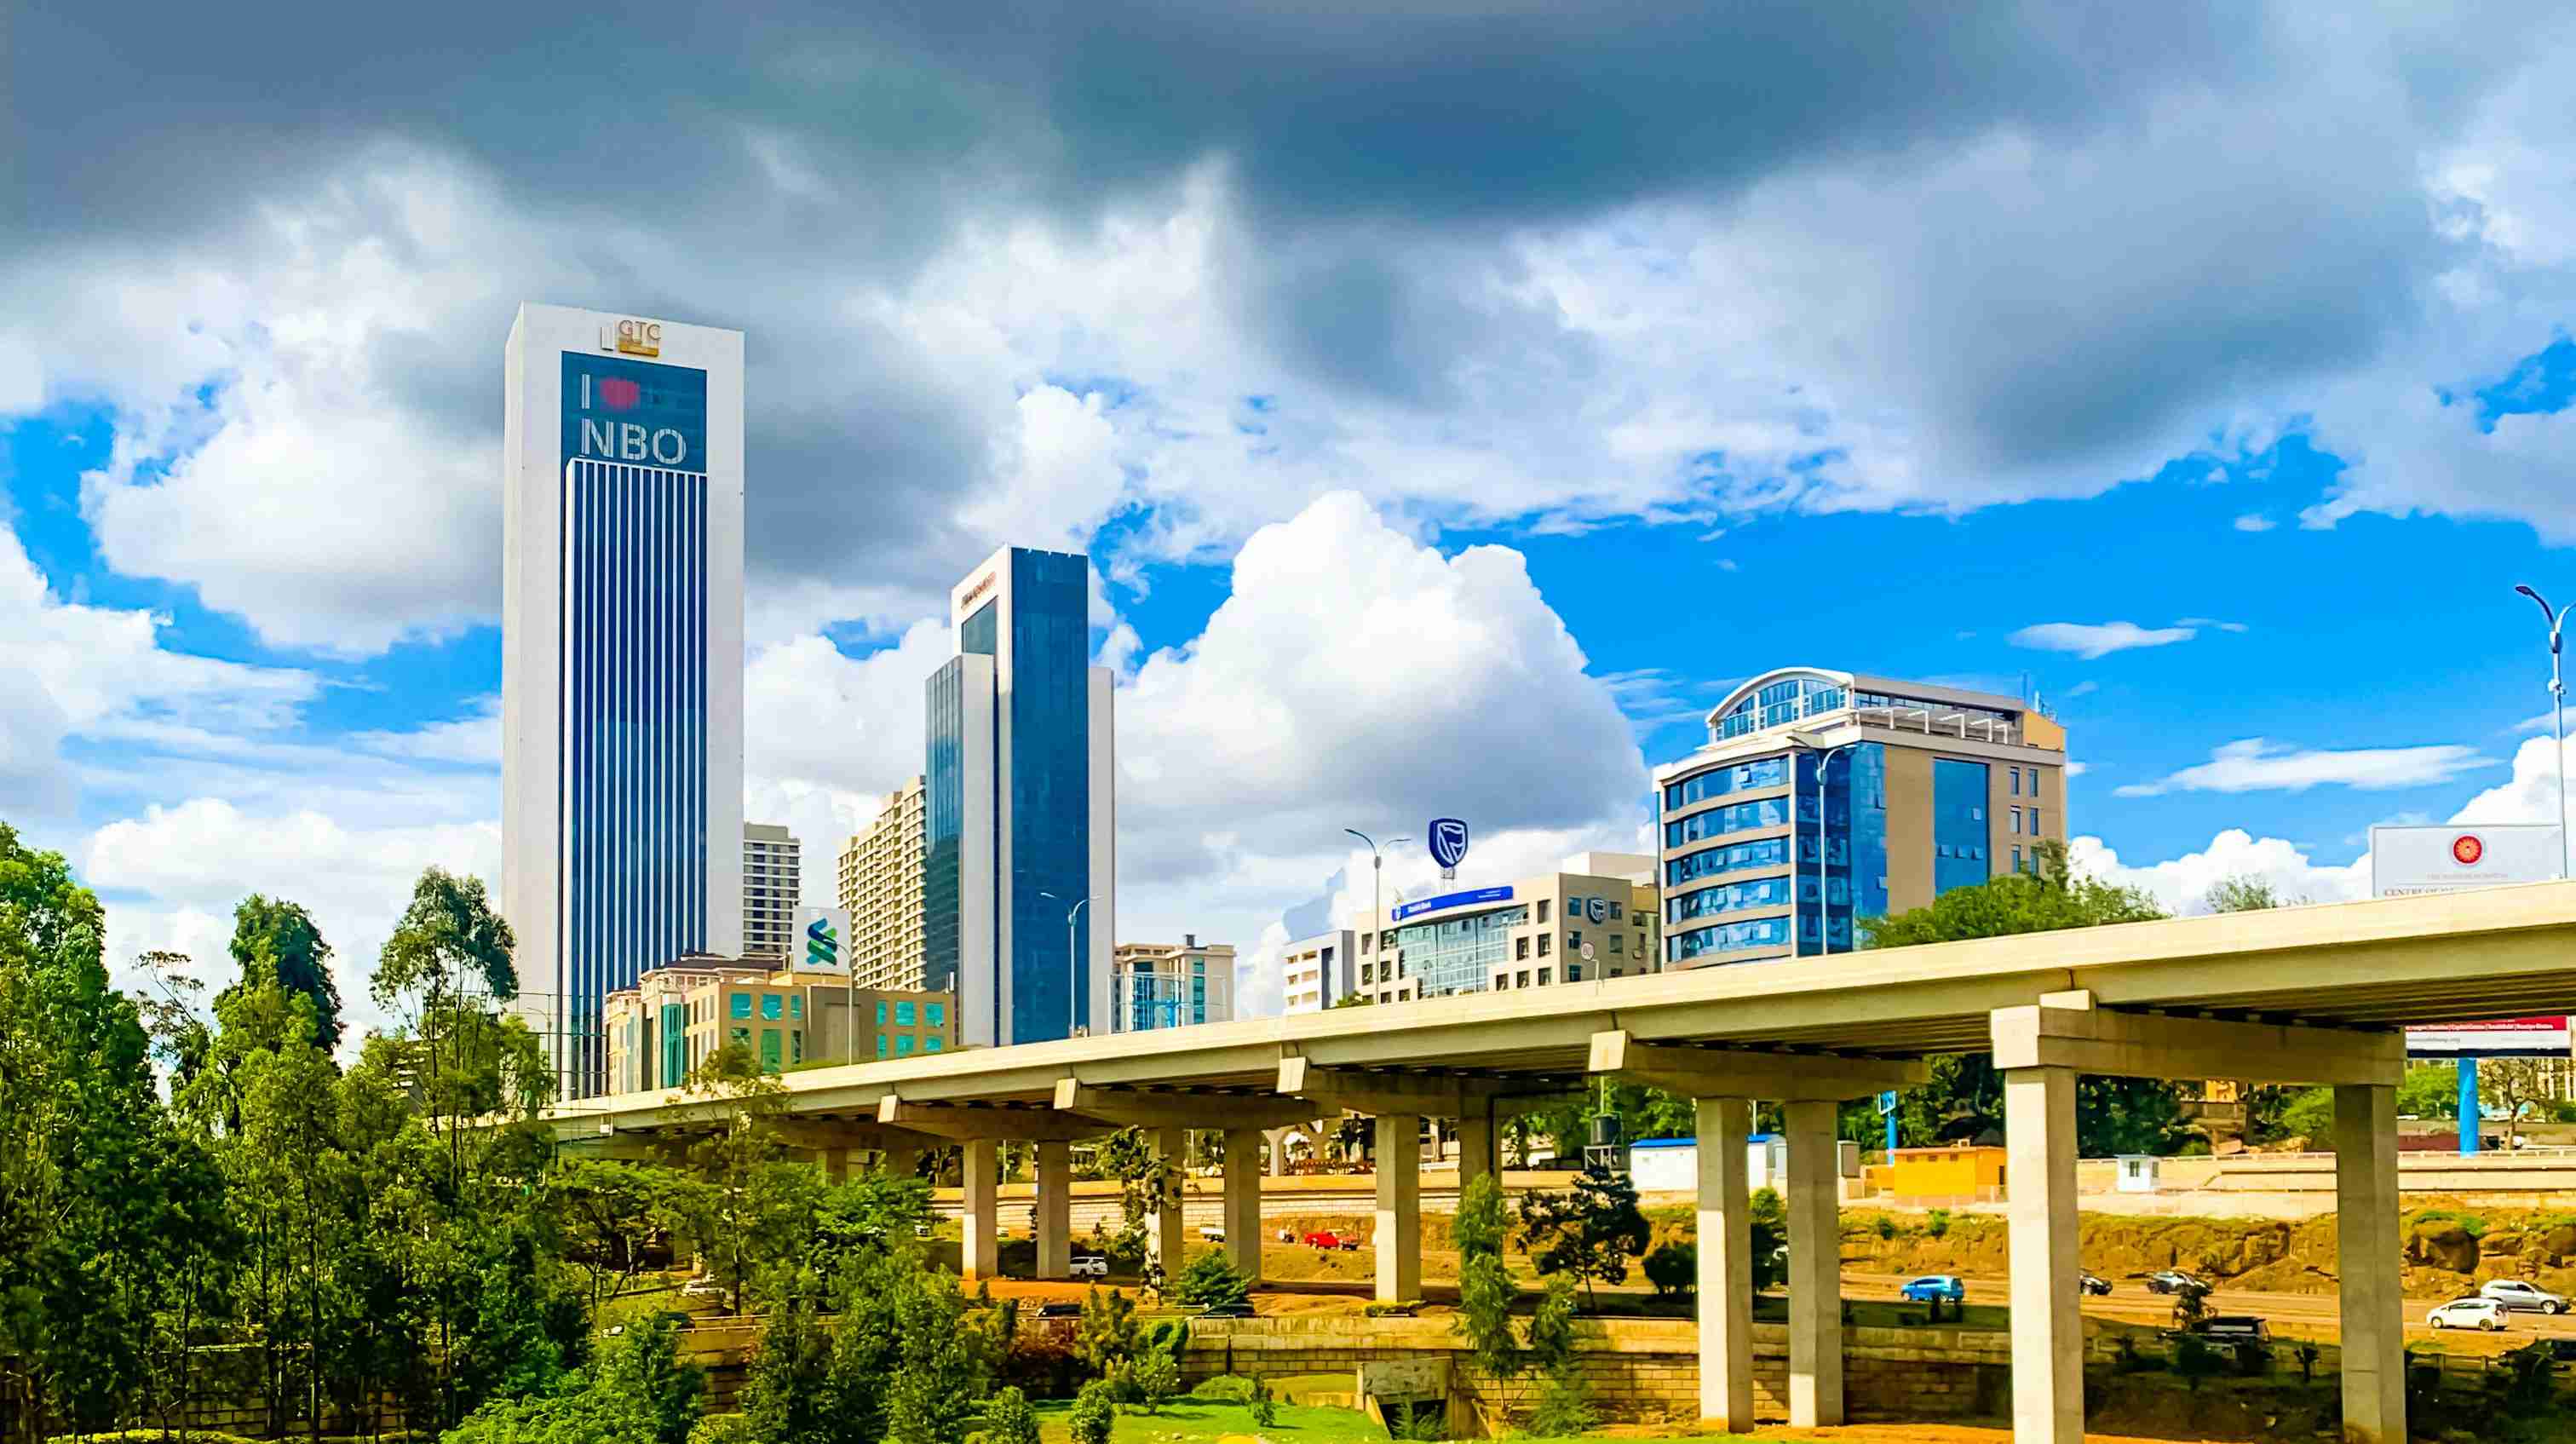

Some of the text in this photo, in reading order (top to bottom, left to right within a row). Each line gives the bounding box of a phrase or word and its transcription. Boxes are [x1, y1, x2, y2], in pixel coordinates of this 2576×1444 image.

[618, 319, 662, 342] GTC
[581, 374, 590, 409] I
[581, 418, 687, 464] NBO
